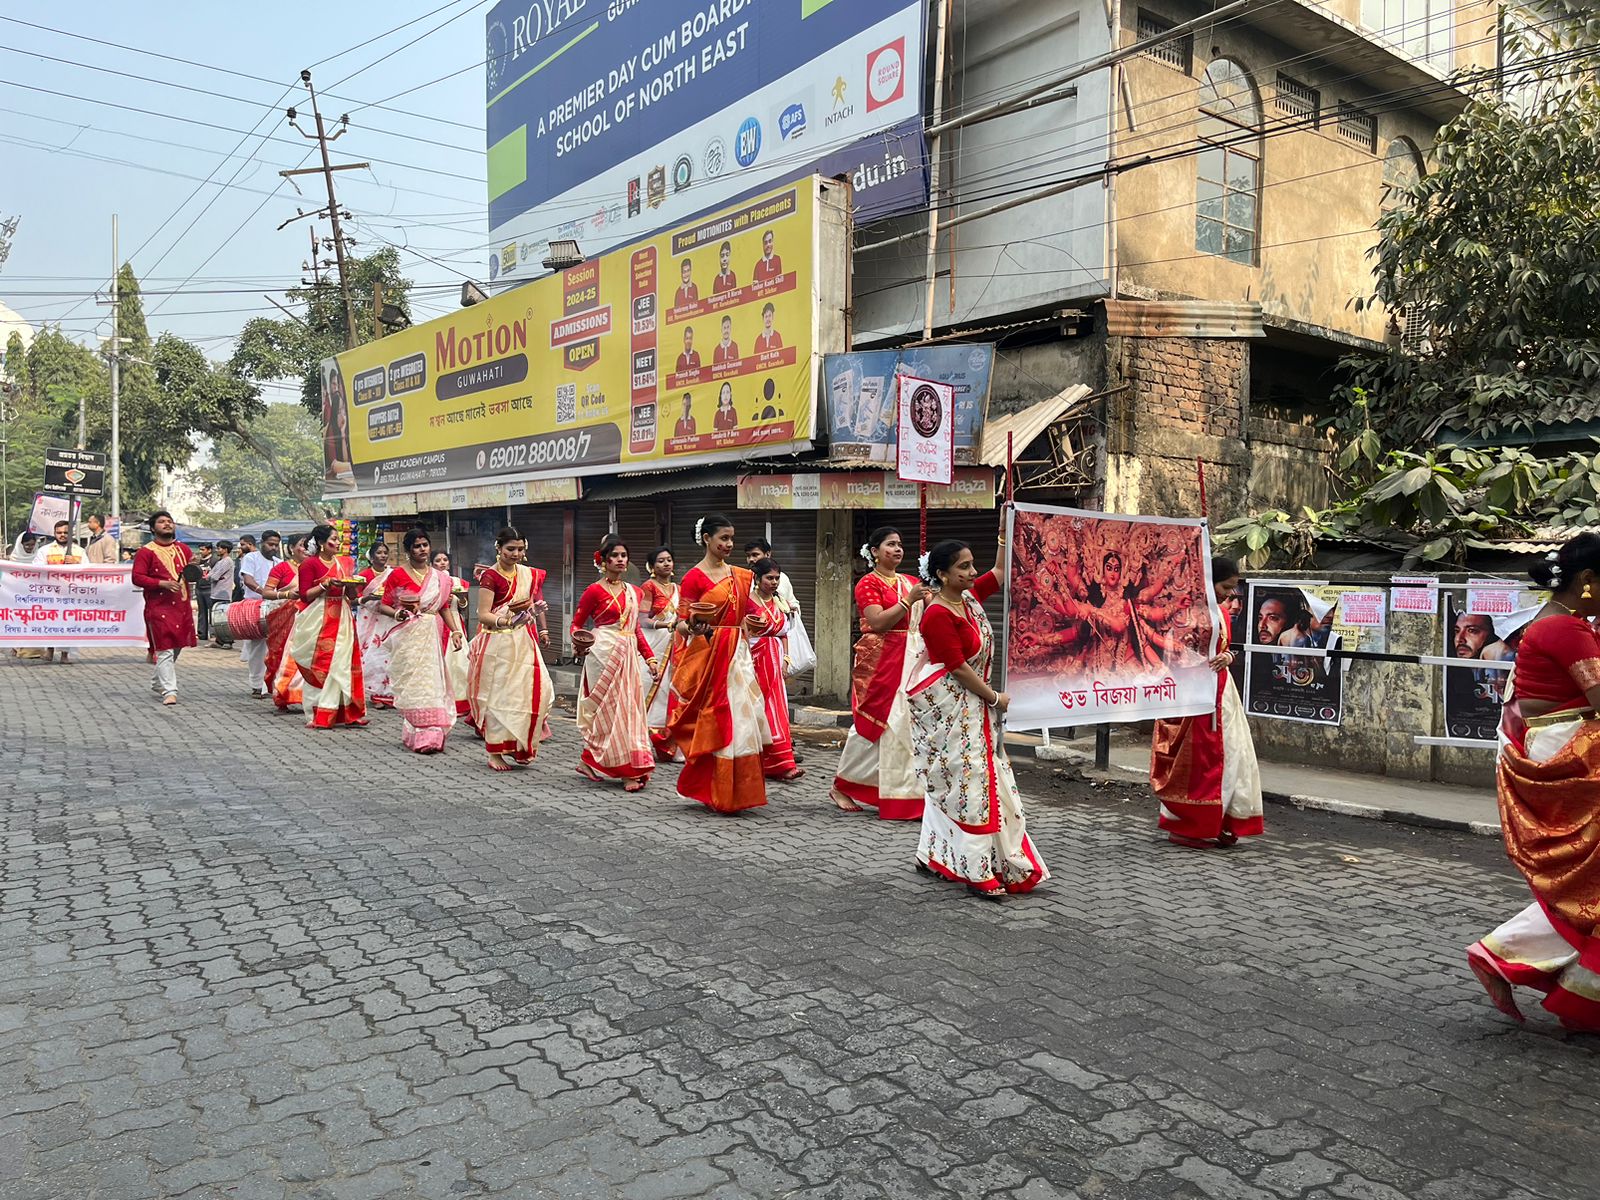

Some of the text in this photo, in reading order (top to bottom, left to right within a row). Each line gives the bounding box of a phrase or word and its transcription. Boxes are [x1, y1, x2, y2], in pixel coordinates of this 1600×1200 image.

[877, 60, 900, 77] ROUND
[877, 69, 900, 86] SQUARE
[537, 117, 546, 138] A
[549, 78, 605, 131] PREMIER
[608, 55, 638, 94] DAY
[641, 30, 677, 72] CUM
[556, 21, 750, 158] SCHOOL OF NORTH EAST
[824, 104, 855, 128] INTACH
[677, 197, 792, 249] Proud MOTIONITES with Placements
[567, 267, 595, 286] Session
[566, 286, 597, 307] 2024-25
[637, 296, 651, 311] JEE
[553, 312, 608, 340] ADMISSIONS
[569, 343, 596, 362] OPEN
[635, 355, 653, 369] NEET
[457, 365, 504, 389] GUWAHATI
[446, 407, 464, 425] আছে
[465, 400, 487, 422] মানেই
[511, 395, 533, 411] আছে
[638, 407, 651, 418] JEE
[489, 430, 593, 470] 69012 88008/7
[382, 453, 445, 471] ASCENT ACADEMY CAMPUS
[400, 469, 427, 482] GUWAHATI
[508, 487, 525, 499] JUPITER
[760, 482, 790, 497] maaza
[847, 479, 881, 496] maaza
[905, 488, 917, 497] CARE
[68, 583, 98, 596] বিভাগ
[1343, 594, 1382, 602] TO-LET SERVICE
[1058, 676, 1177, 710] শুভ বিজয়া দশমী
